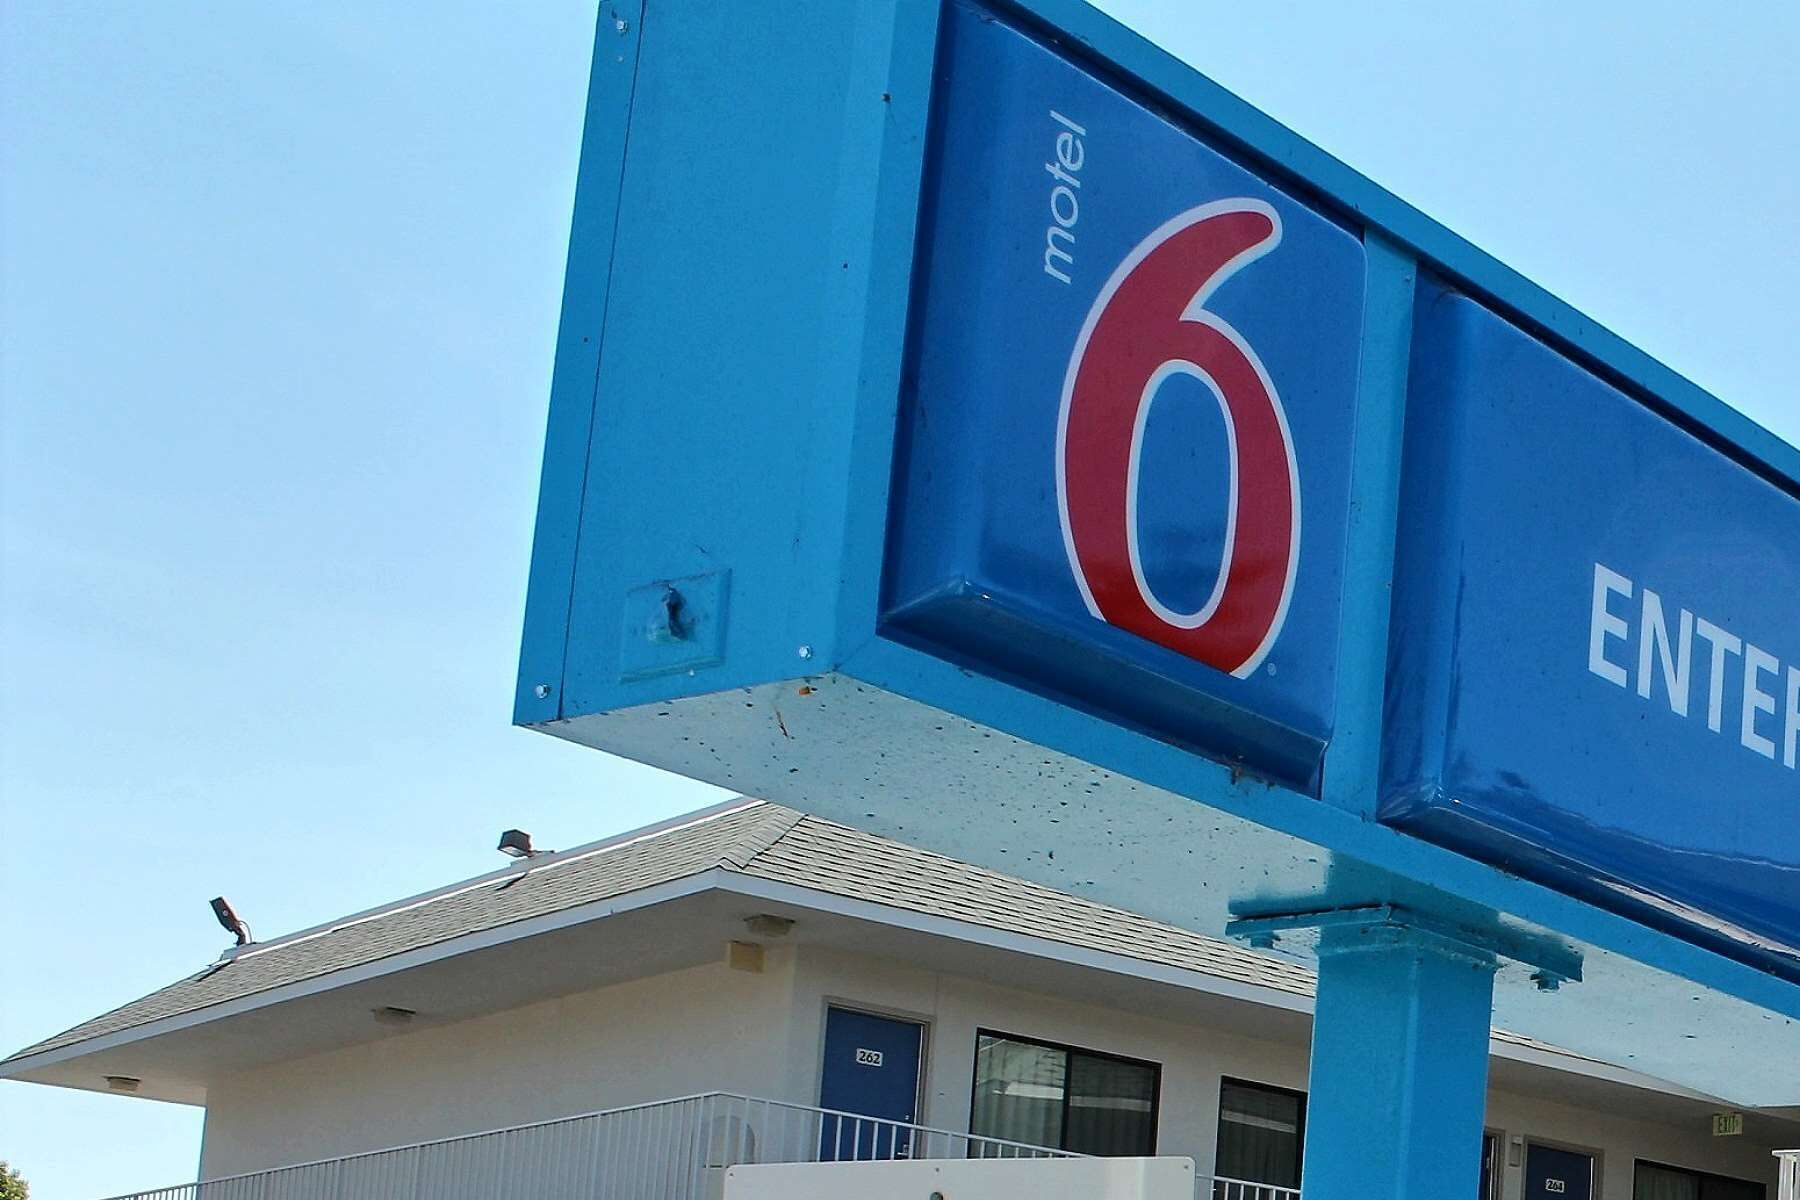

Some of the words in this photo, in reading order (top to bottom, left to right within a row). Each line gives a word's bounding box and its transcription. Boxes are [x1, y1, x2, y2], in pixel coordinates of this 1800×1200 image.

[1044, 110, 1087, 285] motel
[1055, 197, 1303, 681] 6
[859, 1050, 881, 1065] 262
